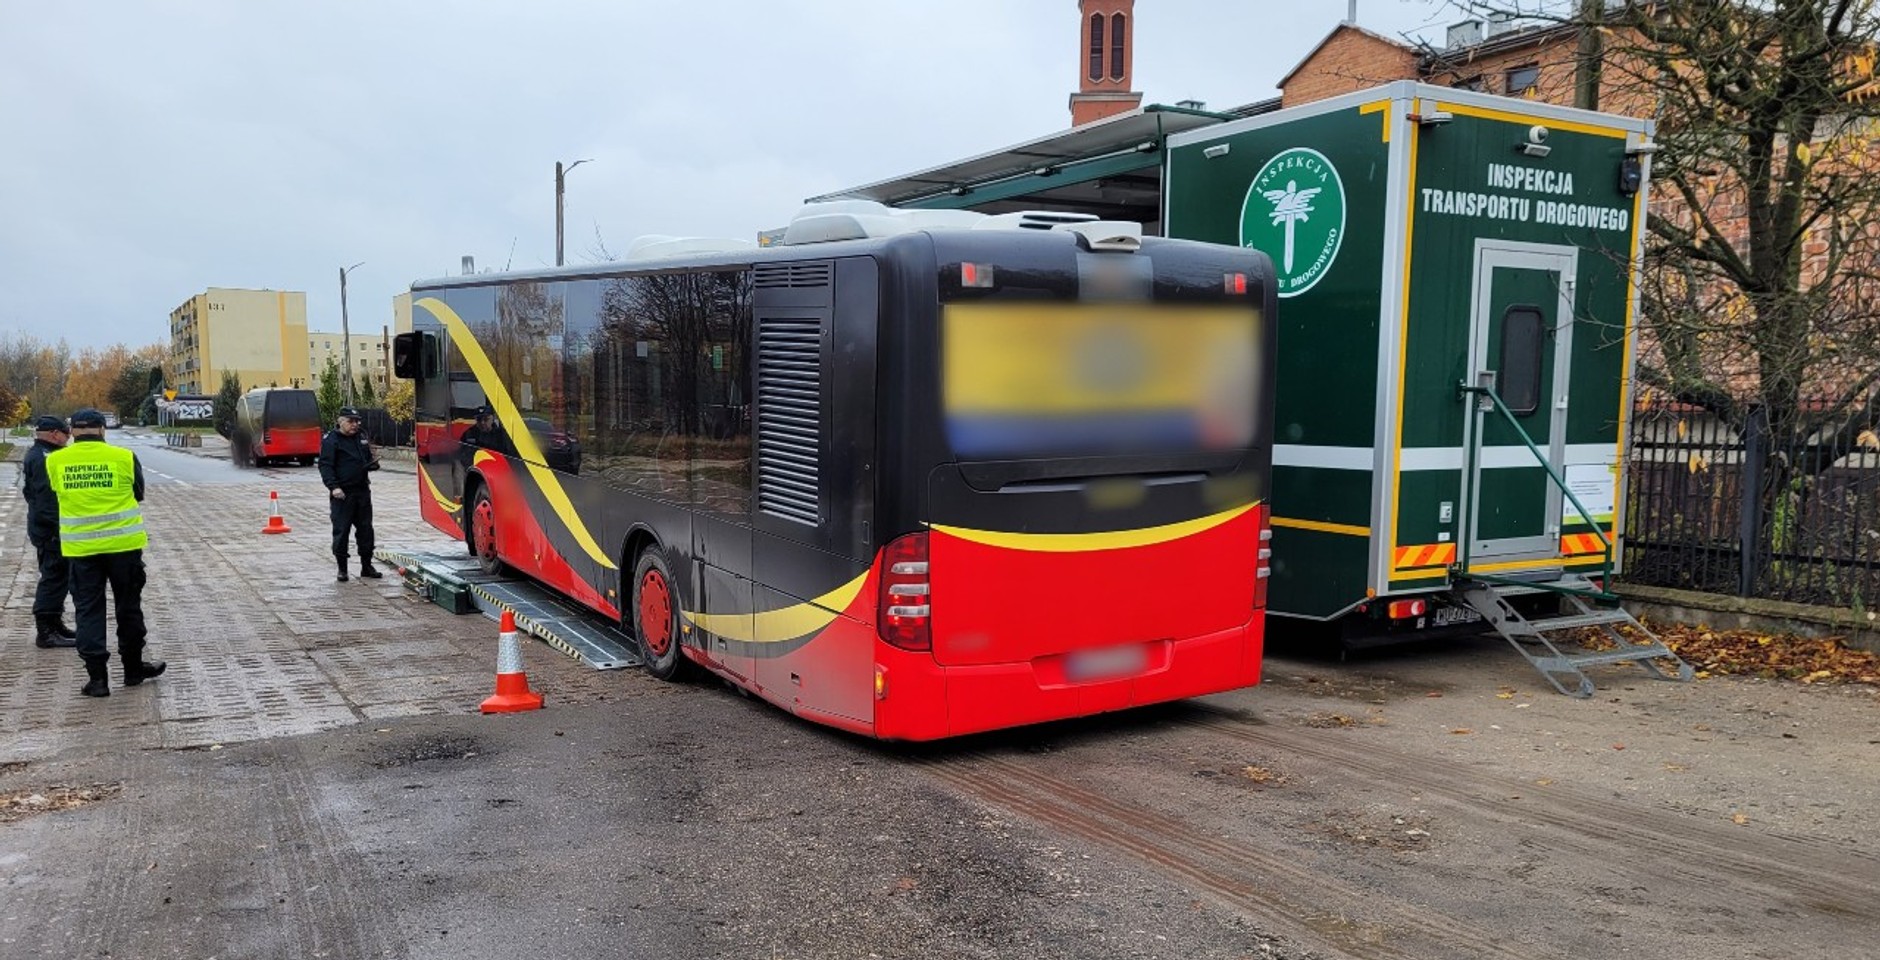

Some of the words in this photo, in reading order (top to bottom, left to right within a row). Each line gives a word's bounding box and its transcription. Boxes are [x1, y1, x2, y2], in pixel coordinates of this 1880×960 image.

[1256, 156, 1328, 193] INSPEKCJA
[1488, 163, 1573, 195] INSPEKCJA
[1422, 188, 1530, 222] TRANSPORTU
[1536, 203, 1629, 232] DROGOWEGO
[1290, 228, 1338, 288] DROGOWEGO
[63, 472, 113, 481] TRANSPORTU
[64, 464, 109, 473] INSPEKCJA
[63, 481, 113, 489] DROGOWEGO
